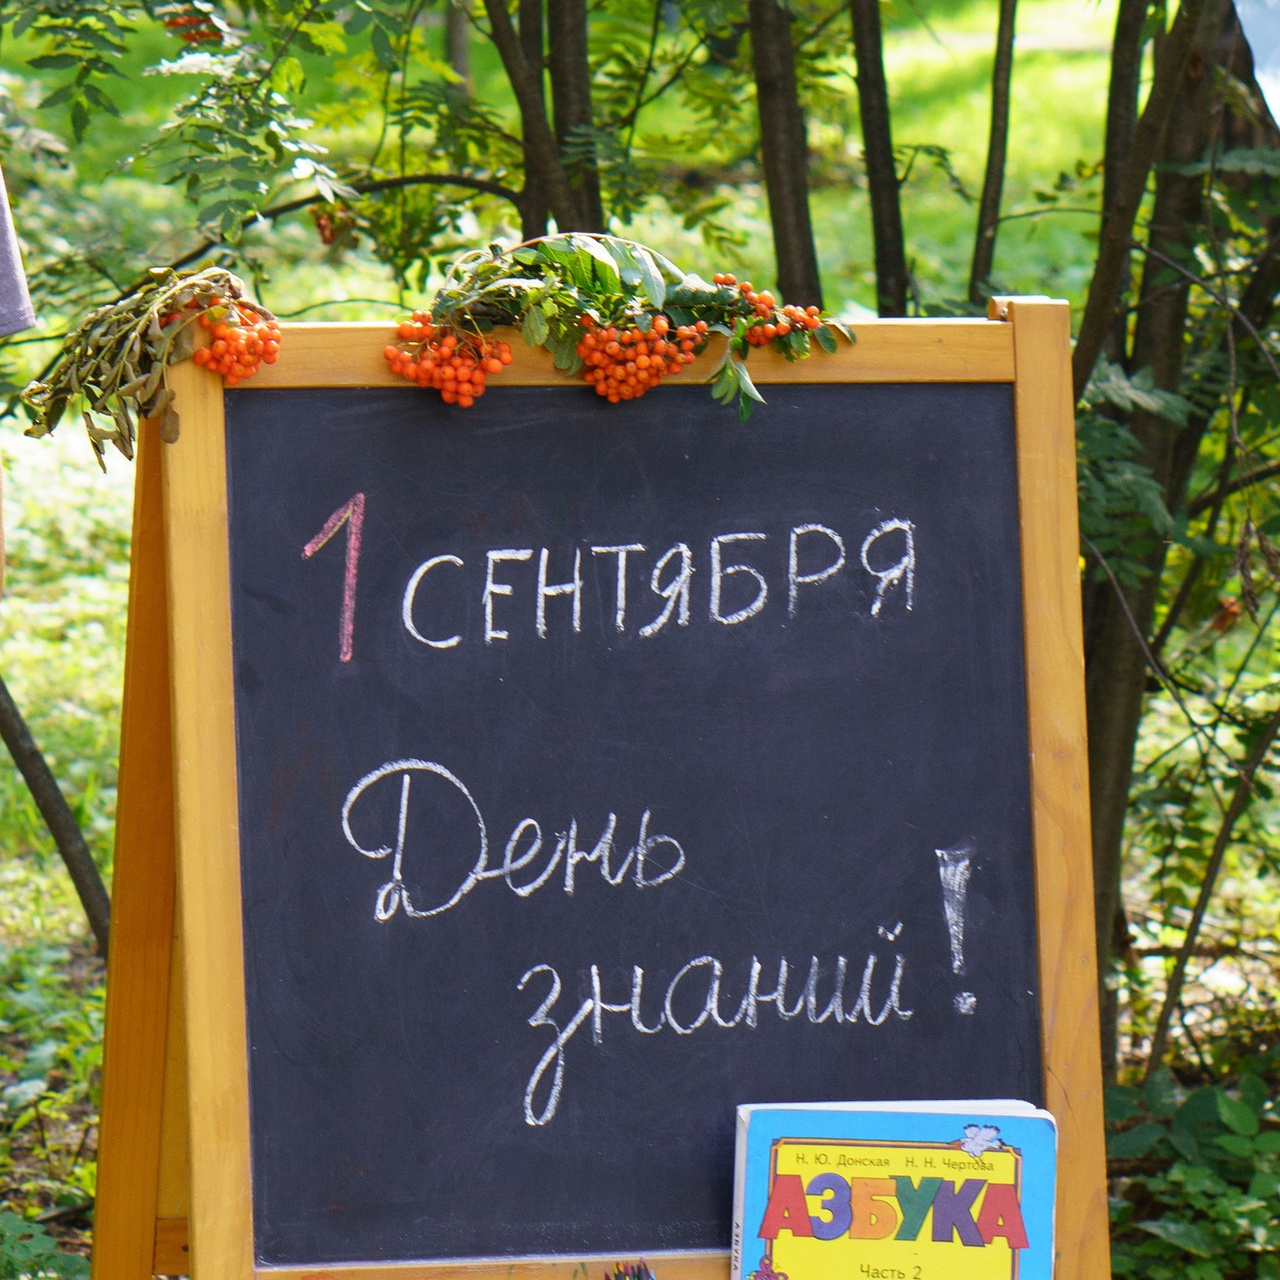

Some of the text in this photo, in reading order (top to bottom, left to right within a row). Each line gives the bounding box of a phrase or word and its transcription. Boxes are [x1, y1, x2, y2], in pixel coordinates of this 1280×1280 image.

[303, 492, 917, 662] 1 СЕНТЯБРЯ
[341, 757, 687, 923] День
[795, 1153, 891, 1168] Н. Ю. Донская
[905, 1156, 995, 1172] Н. Н. Чертова
[757, 1172, 1030, 1249] АЗБУКА
[859, 1263, 923, 1280] Часть 2
